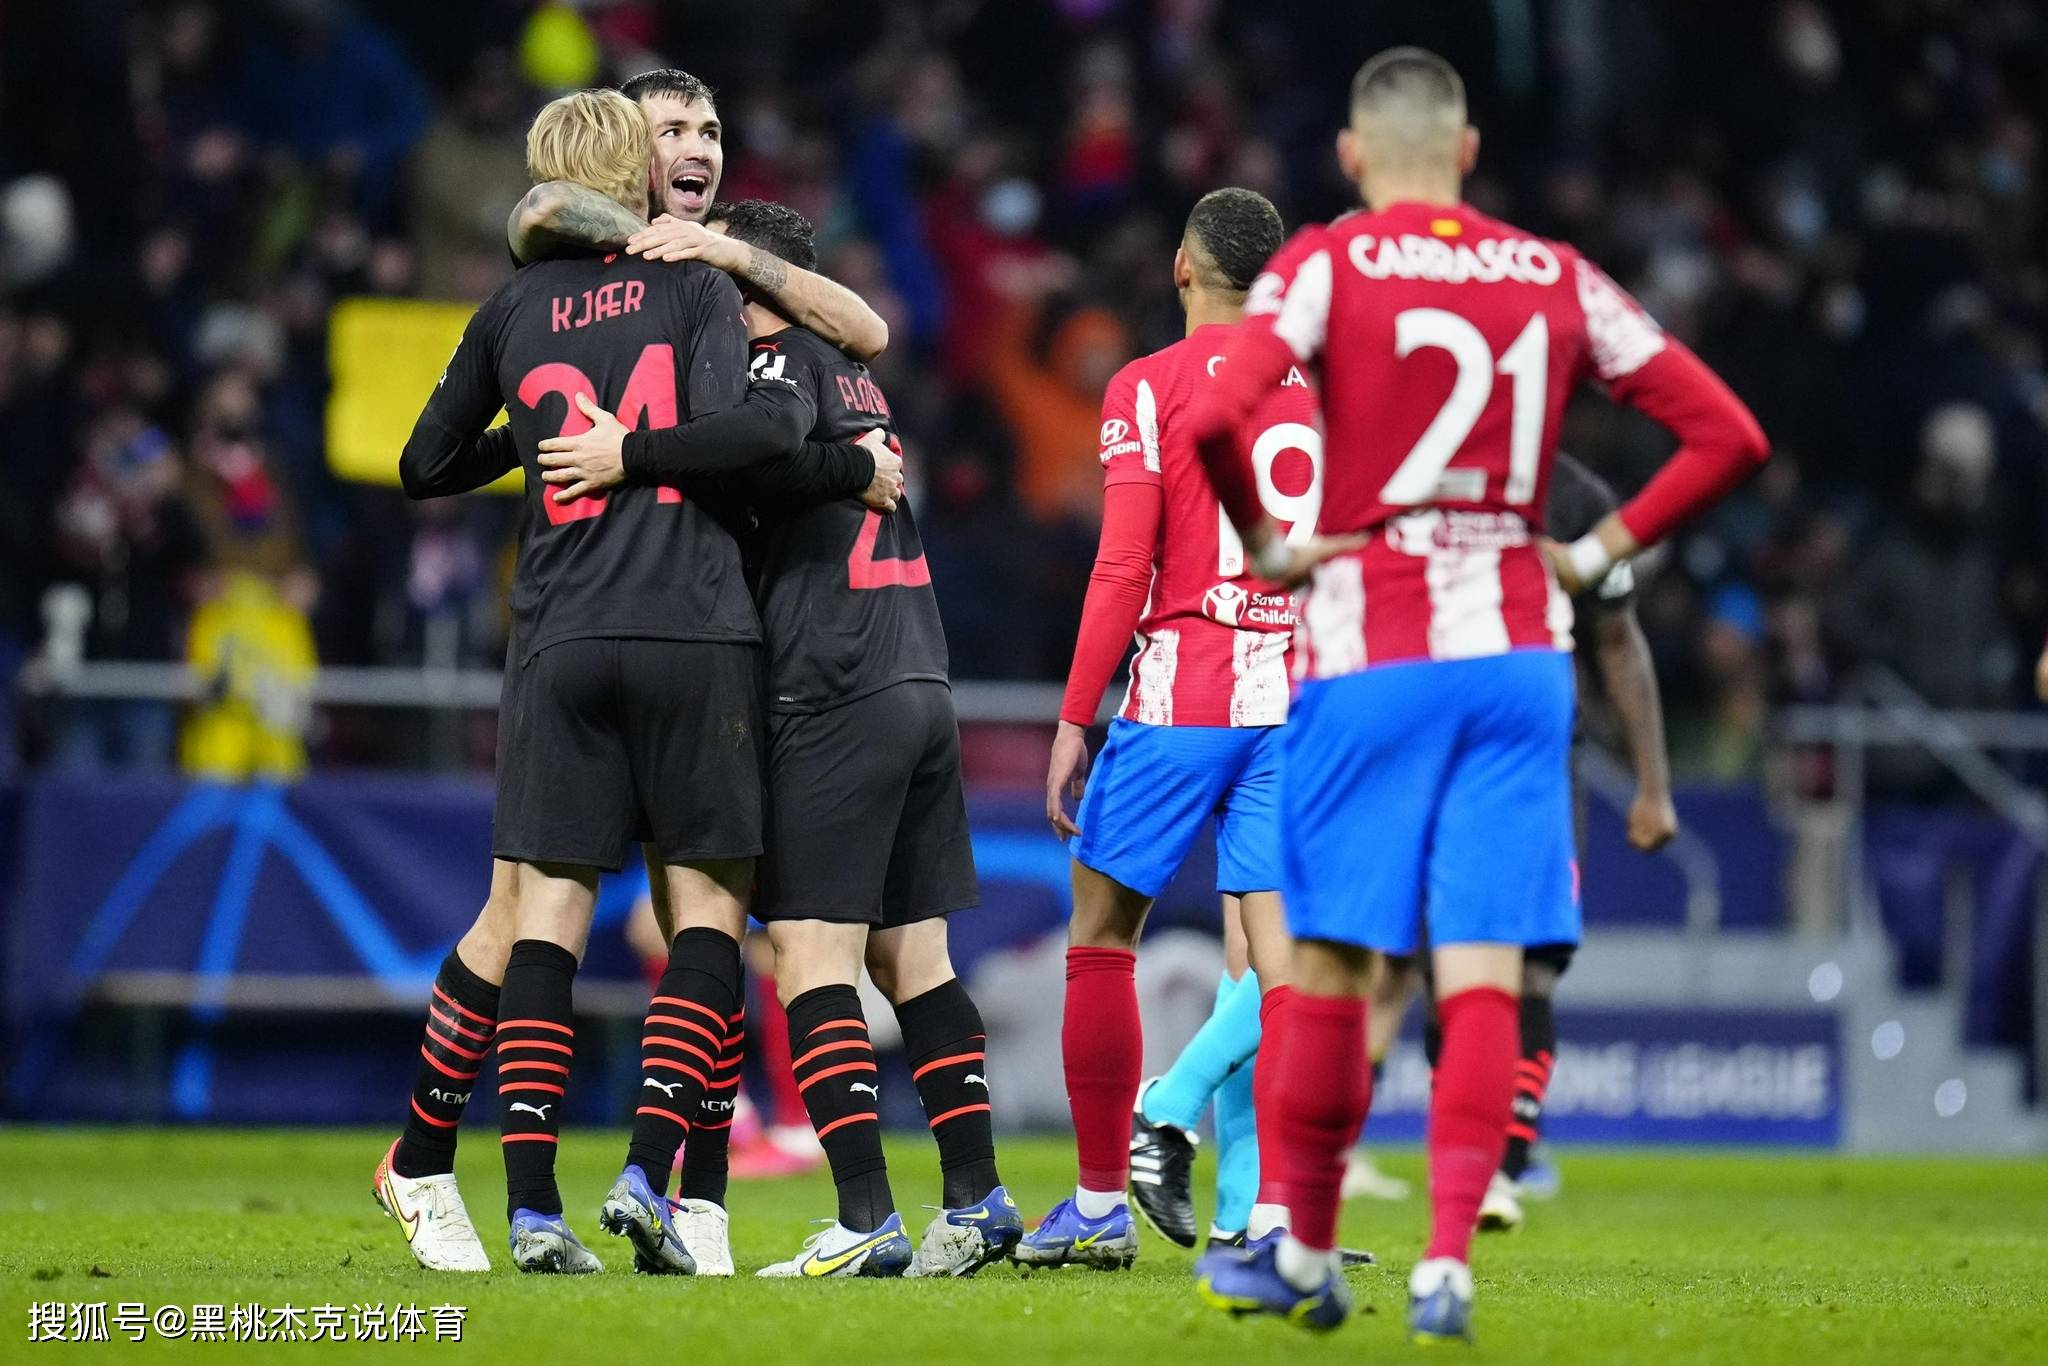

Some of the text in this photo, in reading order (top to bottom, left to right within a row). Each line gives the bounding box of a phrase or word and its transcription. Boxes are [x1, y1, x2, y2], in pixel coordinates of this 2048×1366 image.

[1348, 234, 1562, 285] CARRASCO
[552, 280, 645, 333] KJÆR
[1379, 307, 1549, 505] 21
[1099, 441, 1141, 463] YUNDAI
[1248, 608, 1302, 625] Childre
[1250, 592, 1284, 606] Save
